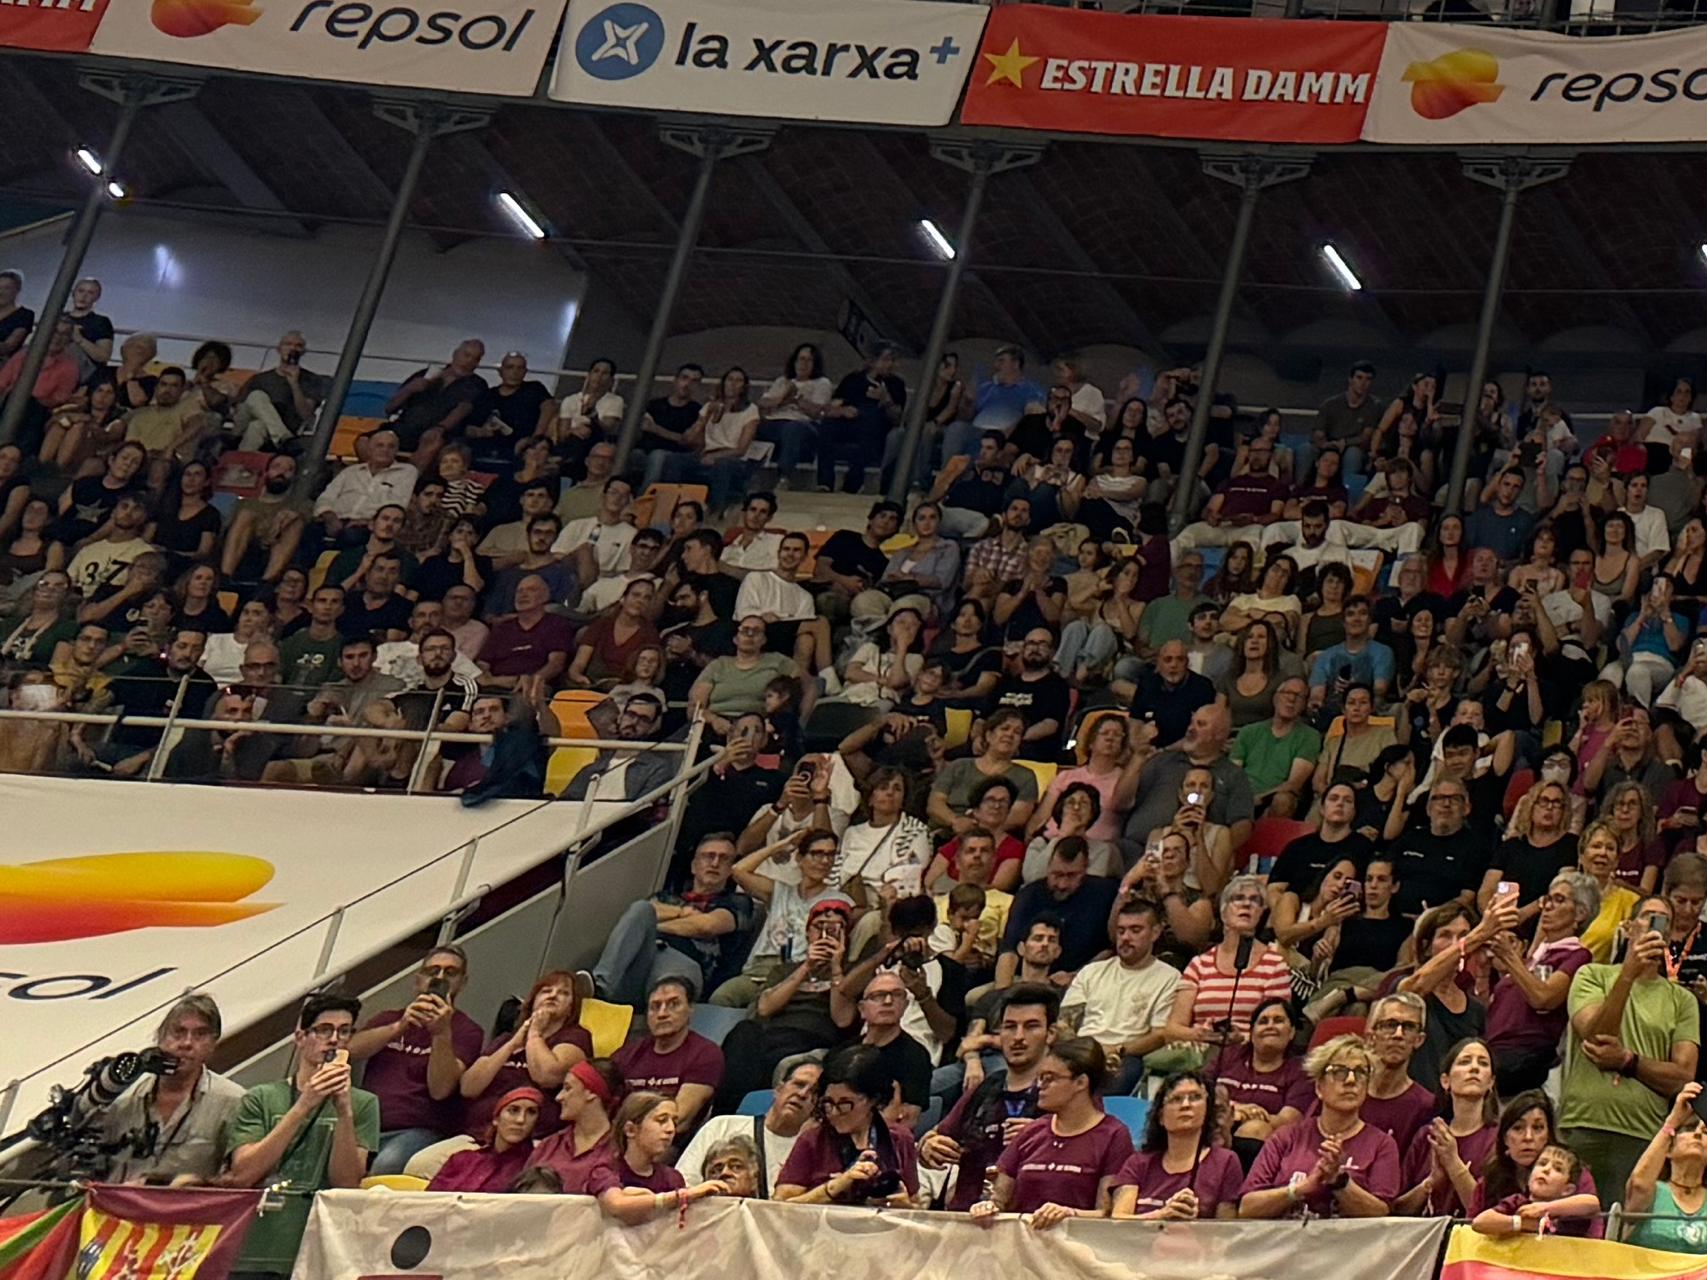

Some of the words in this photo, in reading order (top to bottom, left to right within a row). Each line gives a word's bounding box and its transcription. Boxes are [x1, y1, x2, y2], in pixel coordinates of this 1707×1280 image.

[673, 22, 729, 68] la
[1039, 55, 1233, 100] ESTRELLA
[1243, 69, 1370, 105] DAMM
